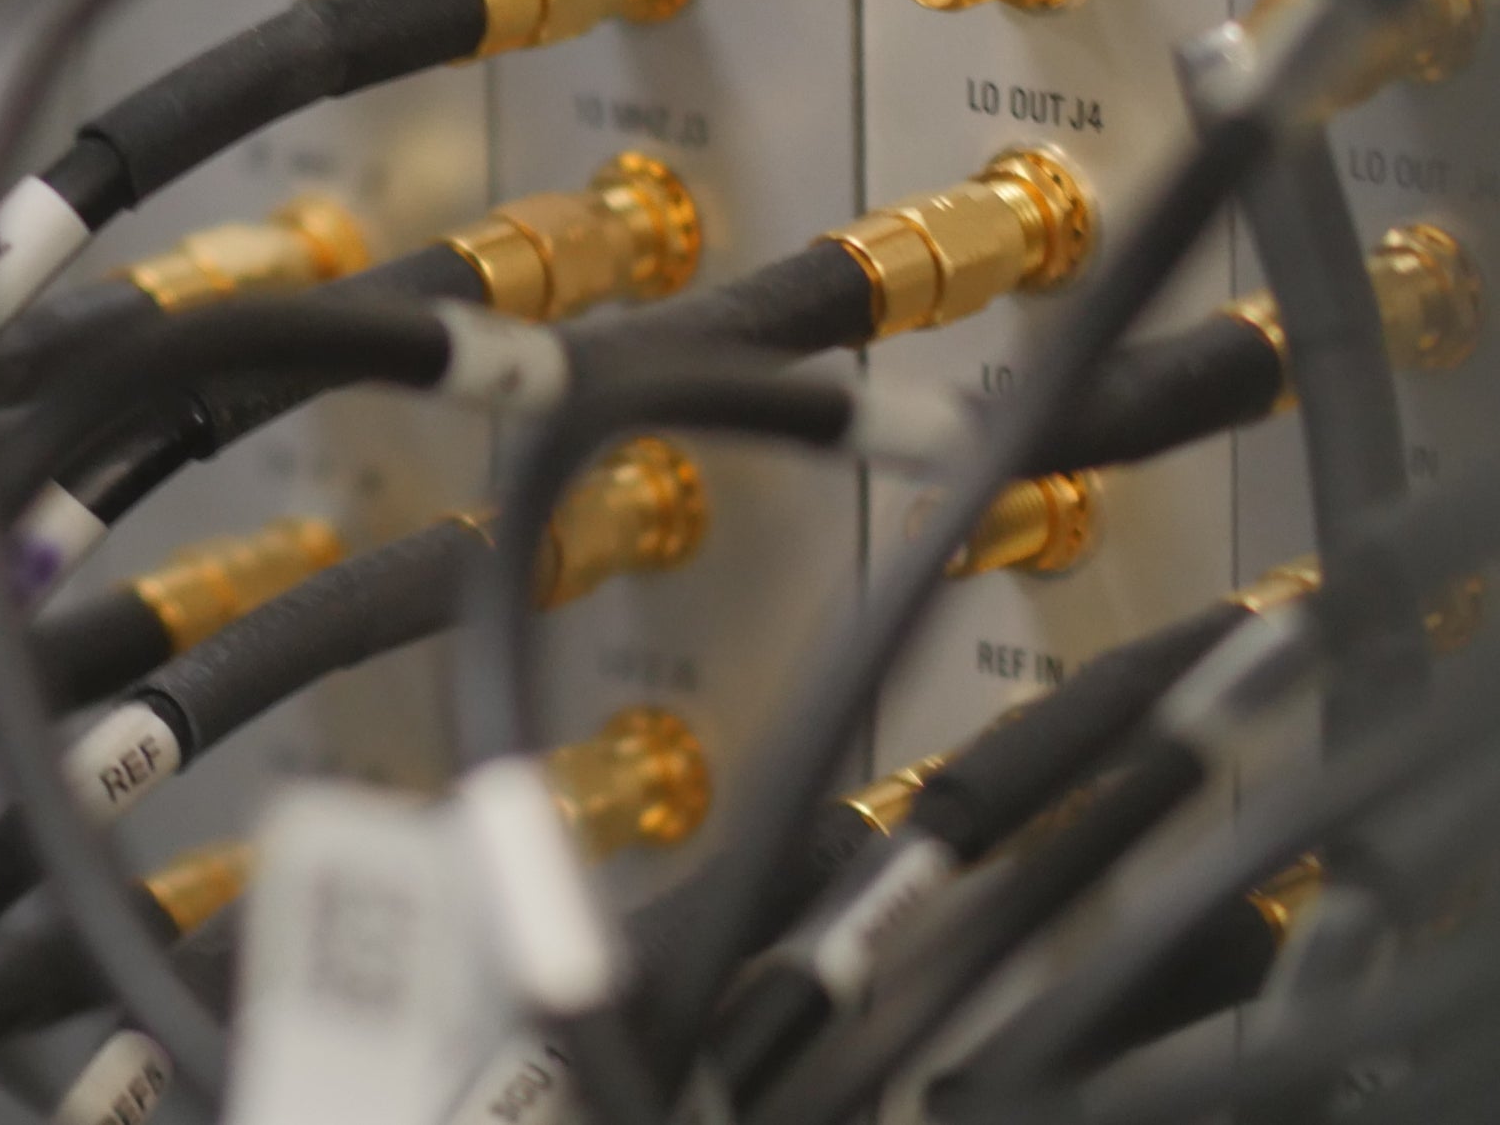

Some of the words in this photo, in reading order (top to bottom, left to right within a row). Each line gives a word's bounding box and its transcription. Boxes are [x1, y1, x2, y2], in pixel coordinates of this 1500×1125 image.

[967, 75, 1000, 116] LO
[1010, 84, 1064, 126] OUT
[1069, 97, 1103, 133] J4
[977, 639, 1024, 681] REF
[1035, 653, 1063, 686] IN
[100, 735, 161, 803] REF
